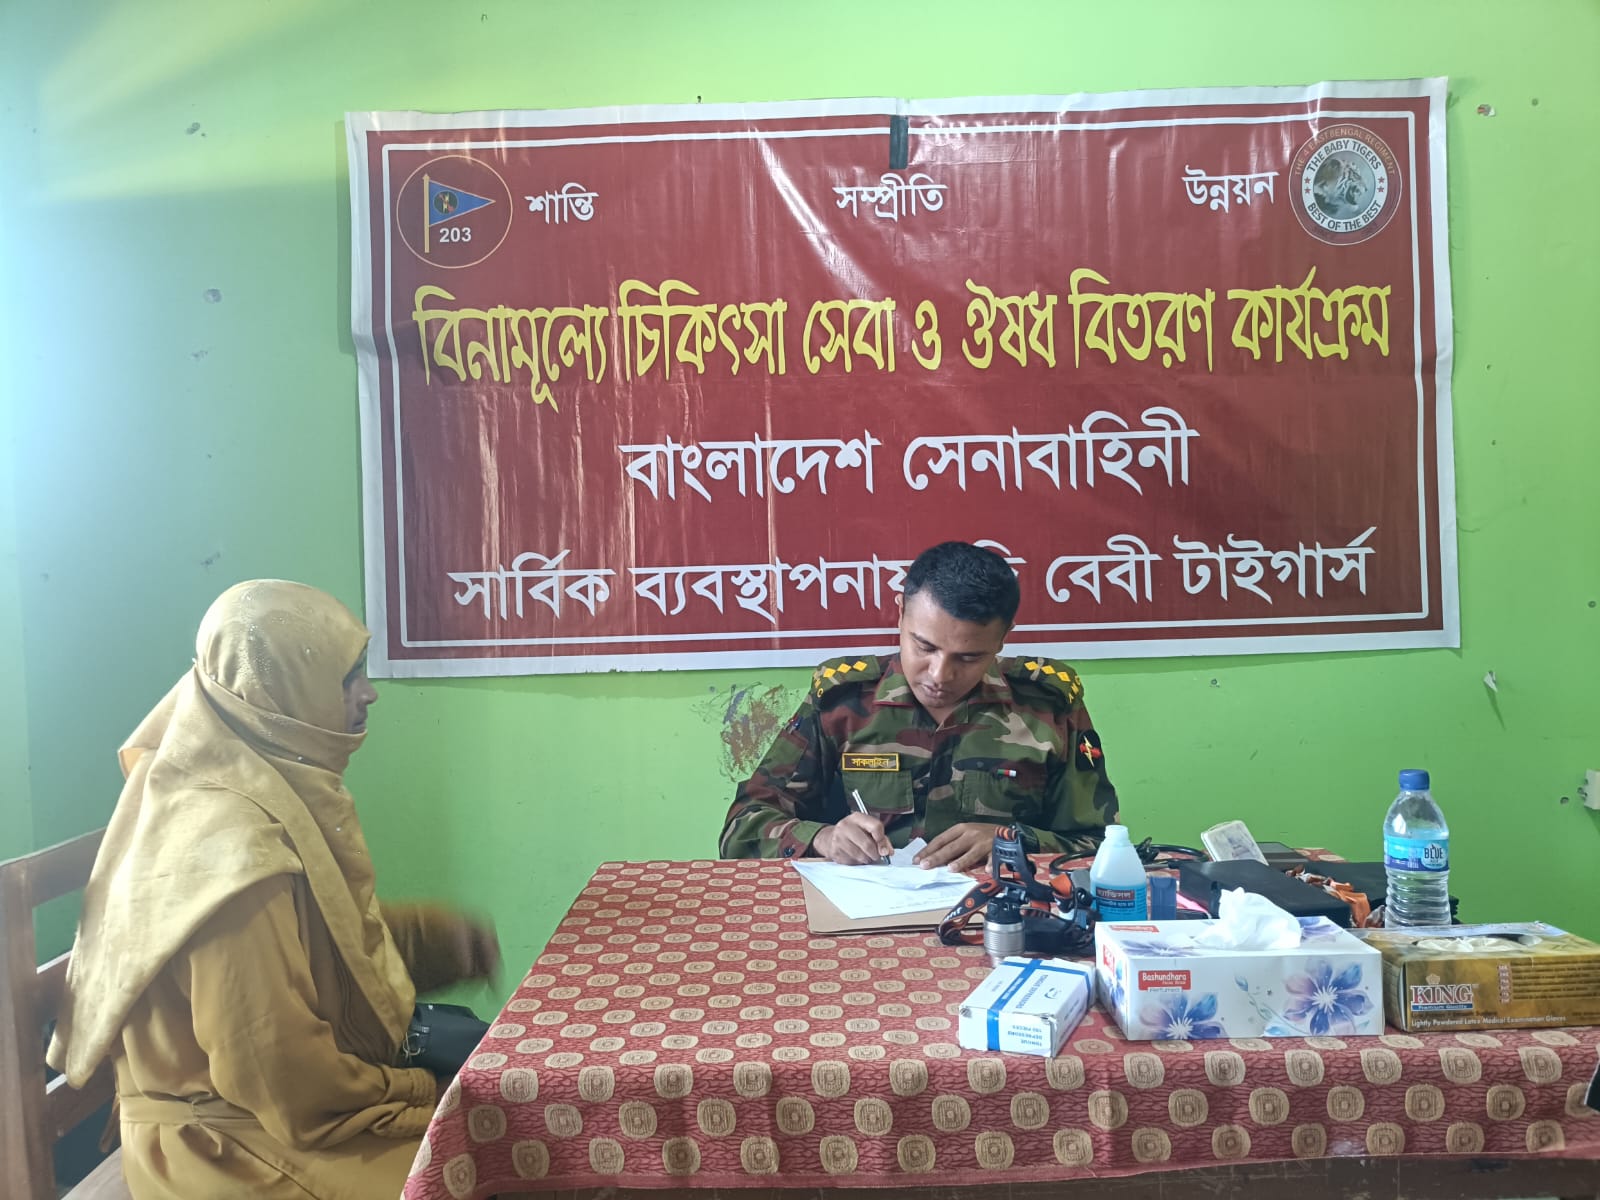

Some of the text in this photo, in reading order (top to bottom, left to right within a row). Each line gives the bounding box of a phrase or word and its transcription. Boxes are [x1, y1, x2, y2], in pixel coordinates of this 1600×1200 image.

[1306, 139, 1382, 172] THE BABY TIGERS
[1329, 127, 1363, 139] BENGAL
[1365, 134, 1395, 176] REGIMENT
[524, 182, 600, 225] শান্তি
[833, 173, 949, 223] সম্প্রীতি
[1181, 165, 1280, 214] উন্নয়ন
[1306, 201, 1329, 225] BEST
[1327, 219, 1342, 231] OF
[1342, 219, 1363, 231] THE
[1362, 200, 1382, 223] BEST
[438, 226, 473, 244] 203
[412, 265, 1392, 413] বিনামূল্যে চিকিৎসা সেবা ও ঔষধ বিতরণ কার্যক্রম
[618, 405, 1201, 504] বাংলাদেশ সেনাবাহিনী
[447, 549, 617, 621] সার্বিক
[1045, 533, 1163, 605] বেবী
[1172, 525, 1378, 605] টাইগার্স
[1423, 847, 1444, 860] BLUE
[1142, 972, 1187, 982] Bashundhara
[1410, 983, 1474, 1005] KING
[1411, 1019, 1432, 1028] Lightly
[1432, 1018, 1464, 1027] Powdered
[1482, 1016, 1506, 1025] Medical
